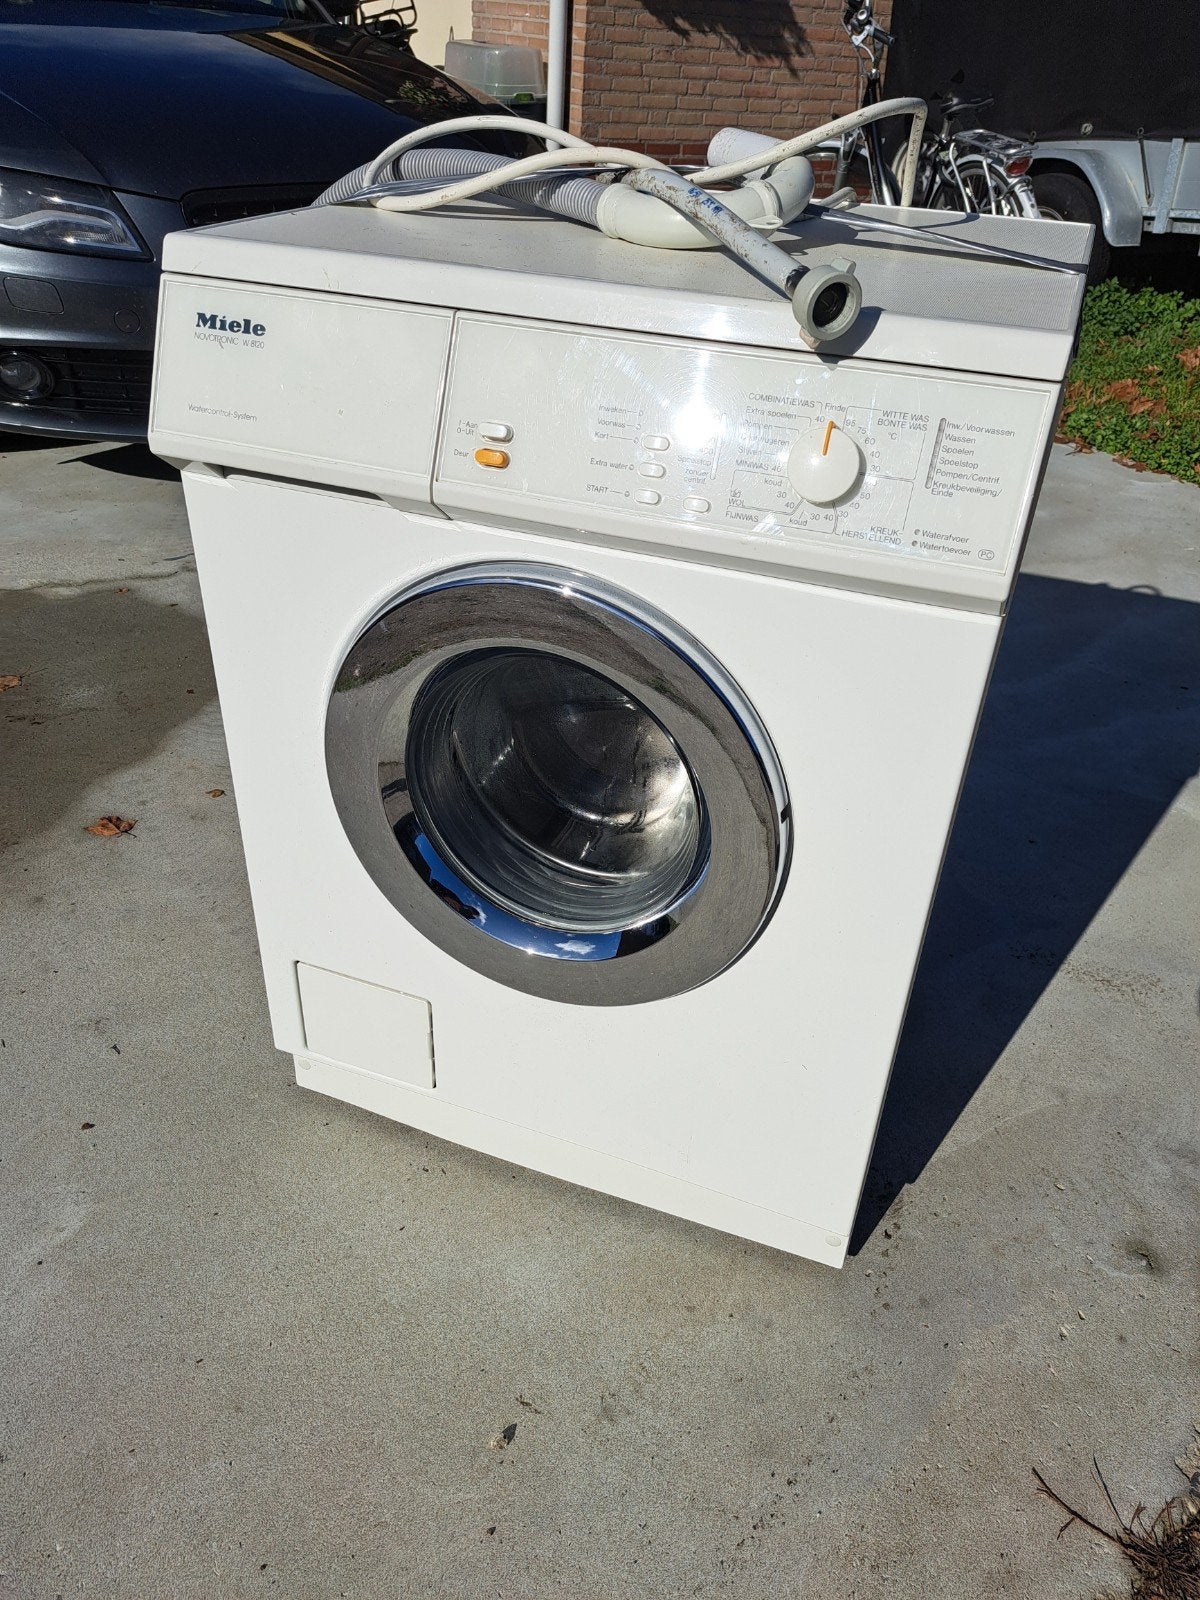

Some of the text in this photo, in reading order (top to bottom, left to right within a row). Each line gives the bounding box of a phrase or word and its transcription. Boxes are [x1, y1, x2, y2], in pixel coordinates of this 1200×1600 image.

[195, 312, 266, 337] Miele
[193, 331, 265, 350] NOVOTRONIC W 8120
[748, 392, 816, 409] COMBINATIEWAS
[188, 402, 258, 422] Watercontrol-System
[745, 405, 797, 420] Extra spoelen
[882, 410, 930, 423] WITTE WAS
[814, 415, 826, 424] 40
[845, 419, 856, 428] 95
[877, 418, 929, 432] BONTE WAS
[594, 431, 609, 440] Kort
[857, 427, 867, 435] 75
[864, 437, 876, 446] 60
[944, 433, 976, 444] Wassen
[453, 448, 470, 458] Deur
[869, 450, 881, 459] 40
[941, 444, 975, 456] Spoelen
[590, 457, 628, 471] Extra water
[939, 456, 979, 470] Spoelstop
[869, 464, 881, 473] 30
[763, 478, 783, 487] koud
[586, 484, 609, 494] START
[931, 487, 954, 498] Einde
[776, 490, 788, 499] 30
[860, 491, 871, 500] 50
[728, 497, 745, 507] WOL
[784, 501, 796, 510] 40
[848, 502, 860, 510] 40
[725, 511, 760, 523] FIJNWAS
[809, 512, 835, 522] 30 40
[838, 511, 849, 519] 30
[789, 516, 809, 527] koud
[841, 529, 902, 546] HERSTELLEND
[922, 529, 970, 544] Waterafvoer
[919, 541, 972, 556] Watertoevoer
